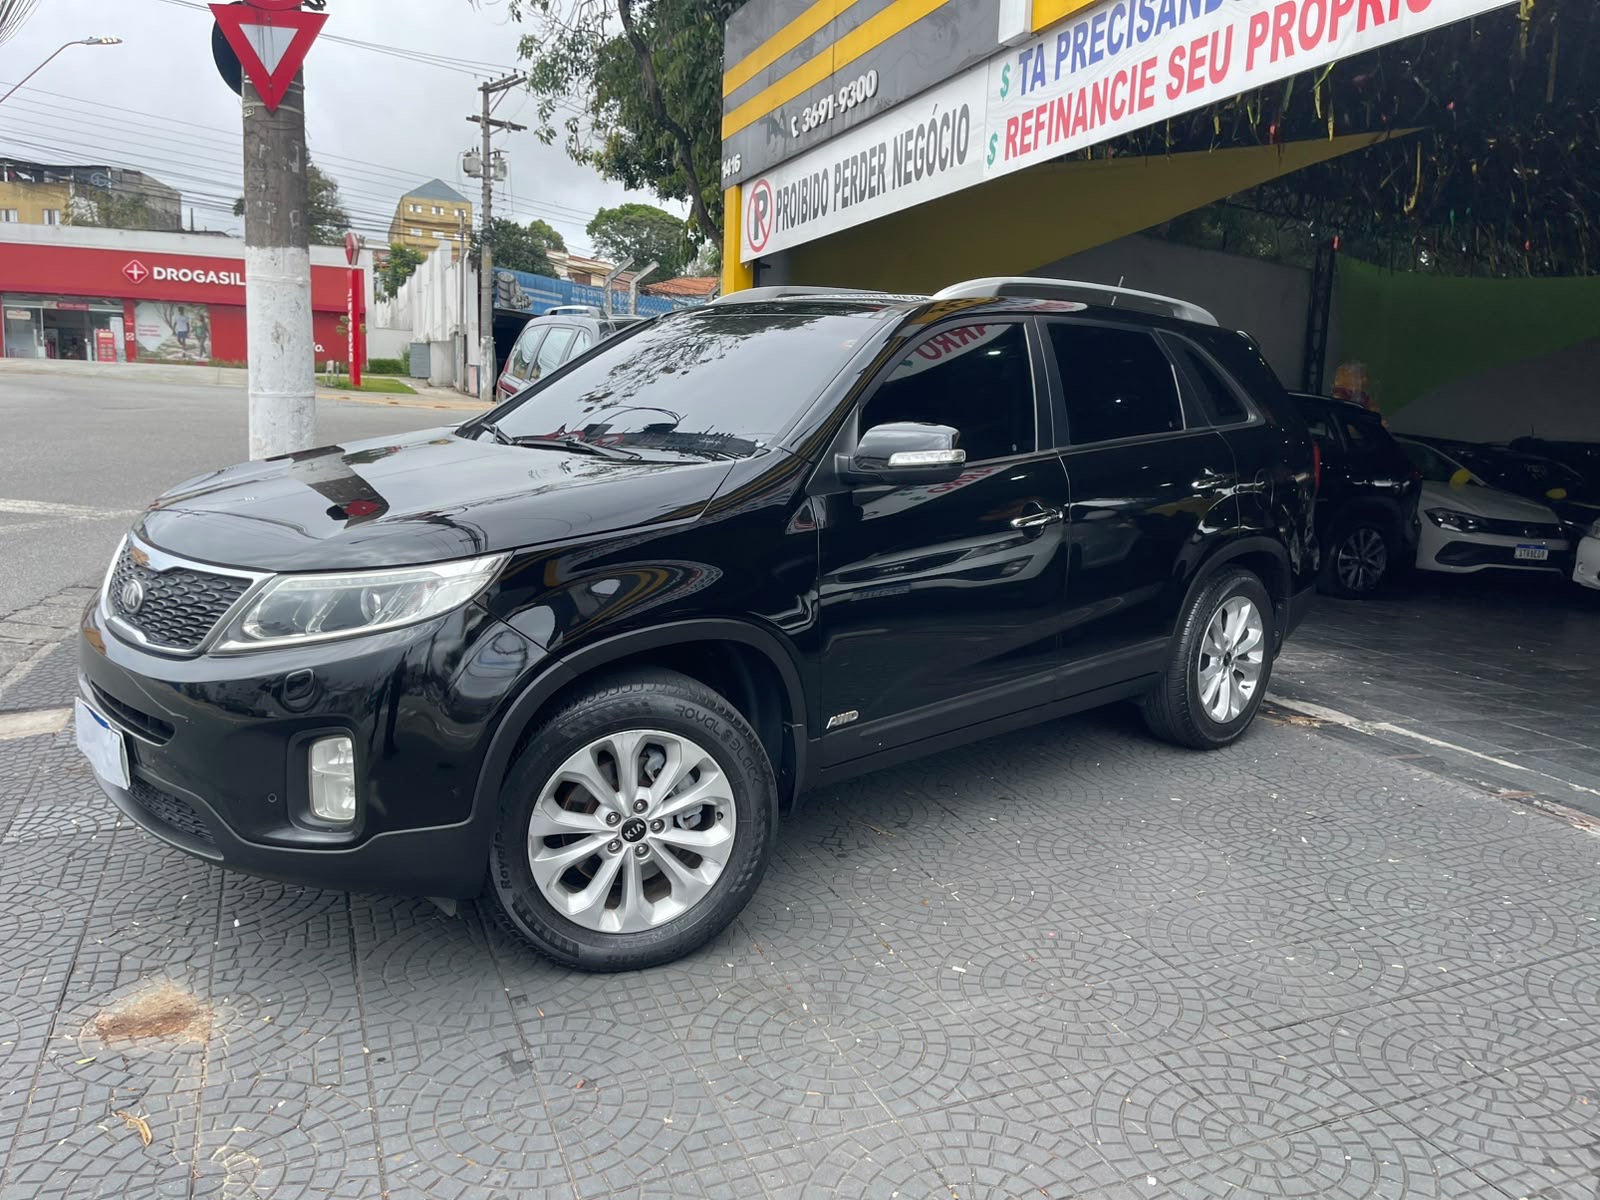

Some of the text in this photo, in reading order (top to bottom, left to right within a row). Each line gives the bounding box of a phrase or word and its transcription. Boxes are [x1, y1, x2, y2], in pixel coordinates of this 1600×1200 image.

[1005, 57, 1158, 160] REFINANCIE
[1166, 24, 1234, 100] SEU
[1018, 46, 1047, 96] TA
[802, 70, 878, 132] 3691-9300
[775, 168, 829, 233] PROIBIDO
[833, 141, 887, 212] PERDER
[892, 103, 970, 190] NEGÓCIO
[153, 266, 246, 286] DROGASIL
[624, 822, 645, 840] KIA
